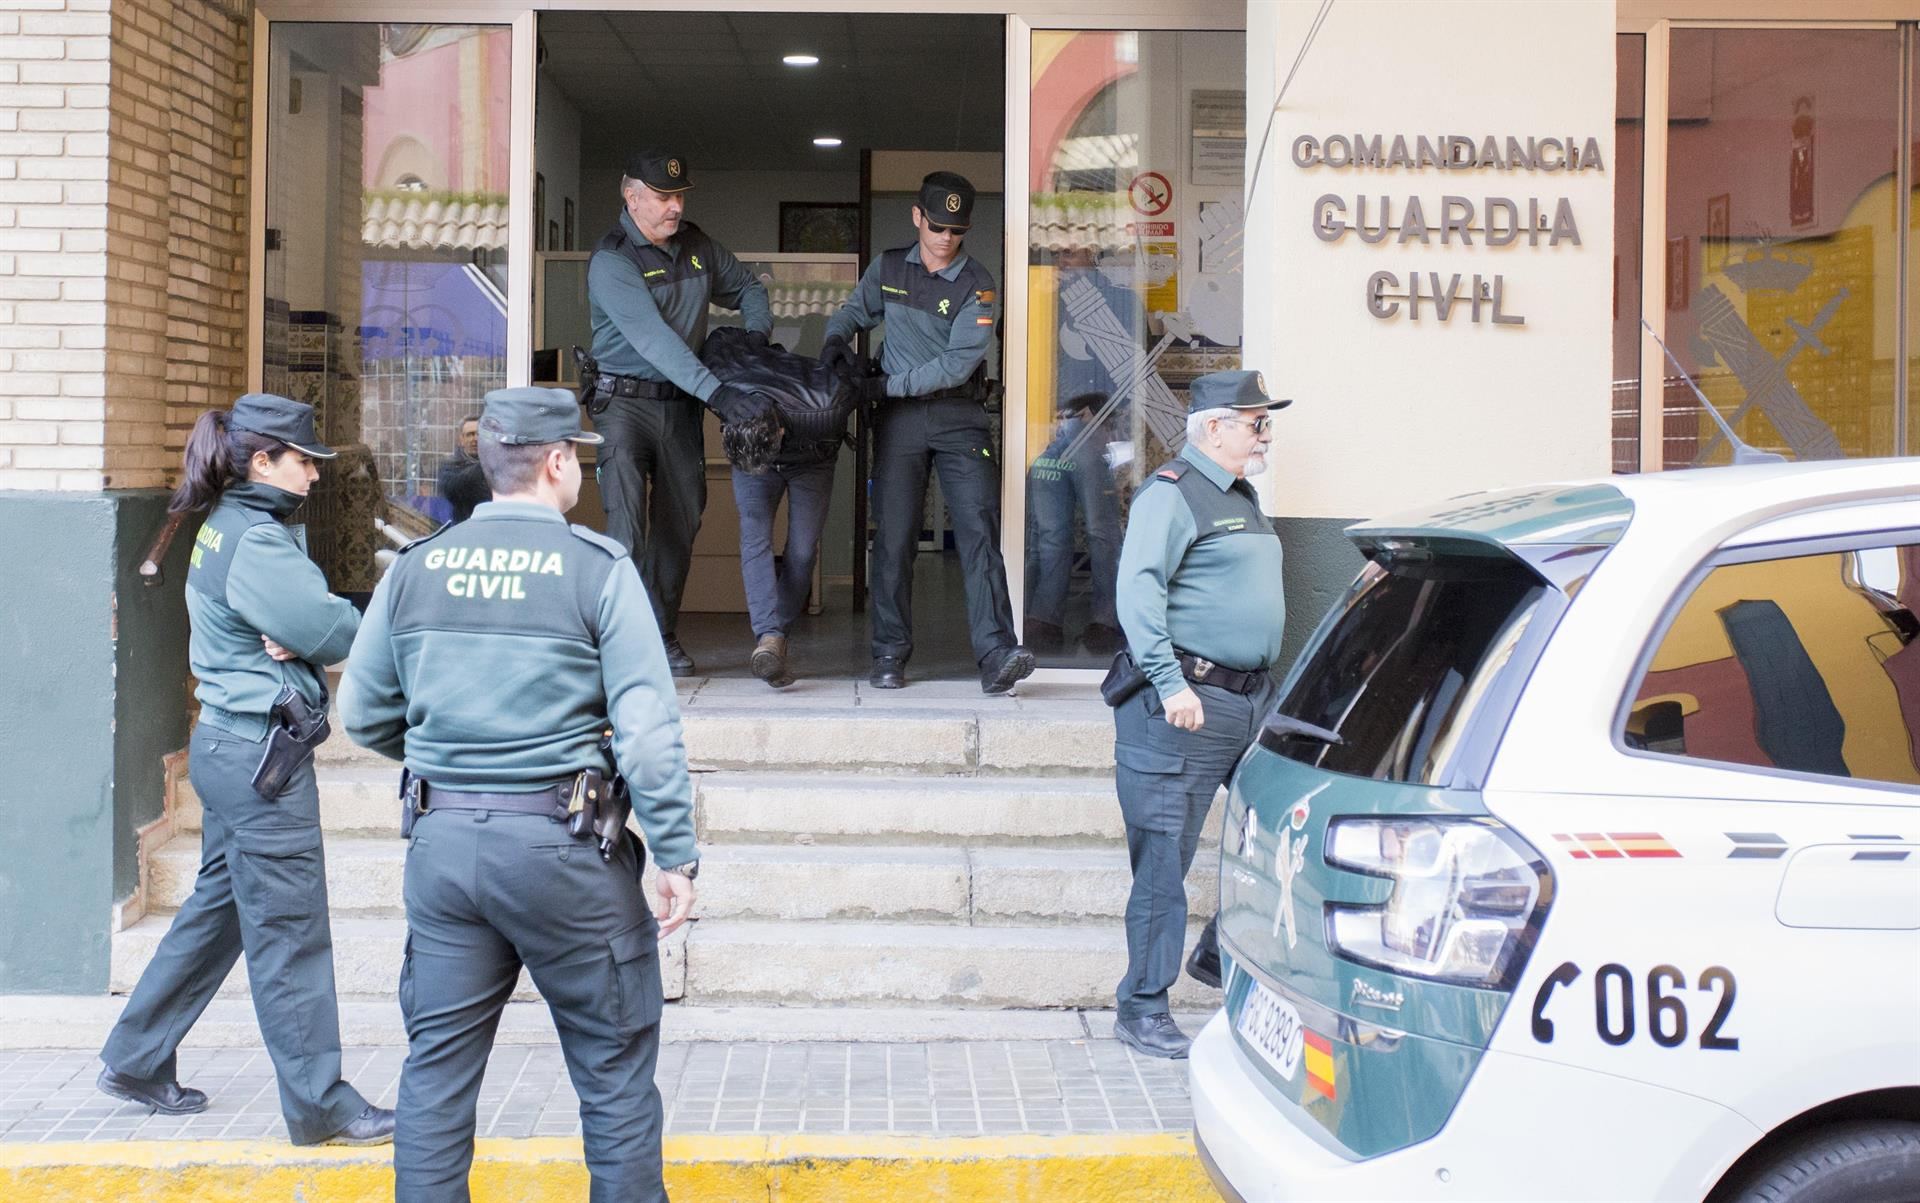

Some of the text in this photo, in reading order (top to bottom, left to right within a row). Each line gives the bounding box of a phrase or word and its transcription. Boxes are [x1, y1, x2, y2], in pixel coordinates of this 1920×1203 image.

[1292, 134, 1604, 171] COMANDANCIA
[1312, 193, 1582, 246] GUARDIA
[1367, 270, 1525, 325] CIVIL
[424, 547, 564, 576] GUARDIA
[446, 573, 527, 600] CIVIL
[1594, 963, 1740, 1051] 062
